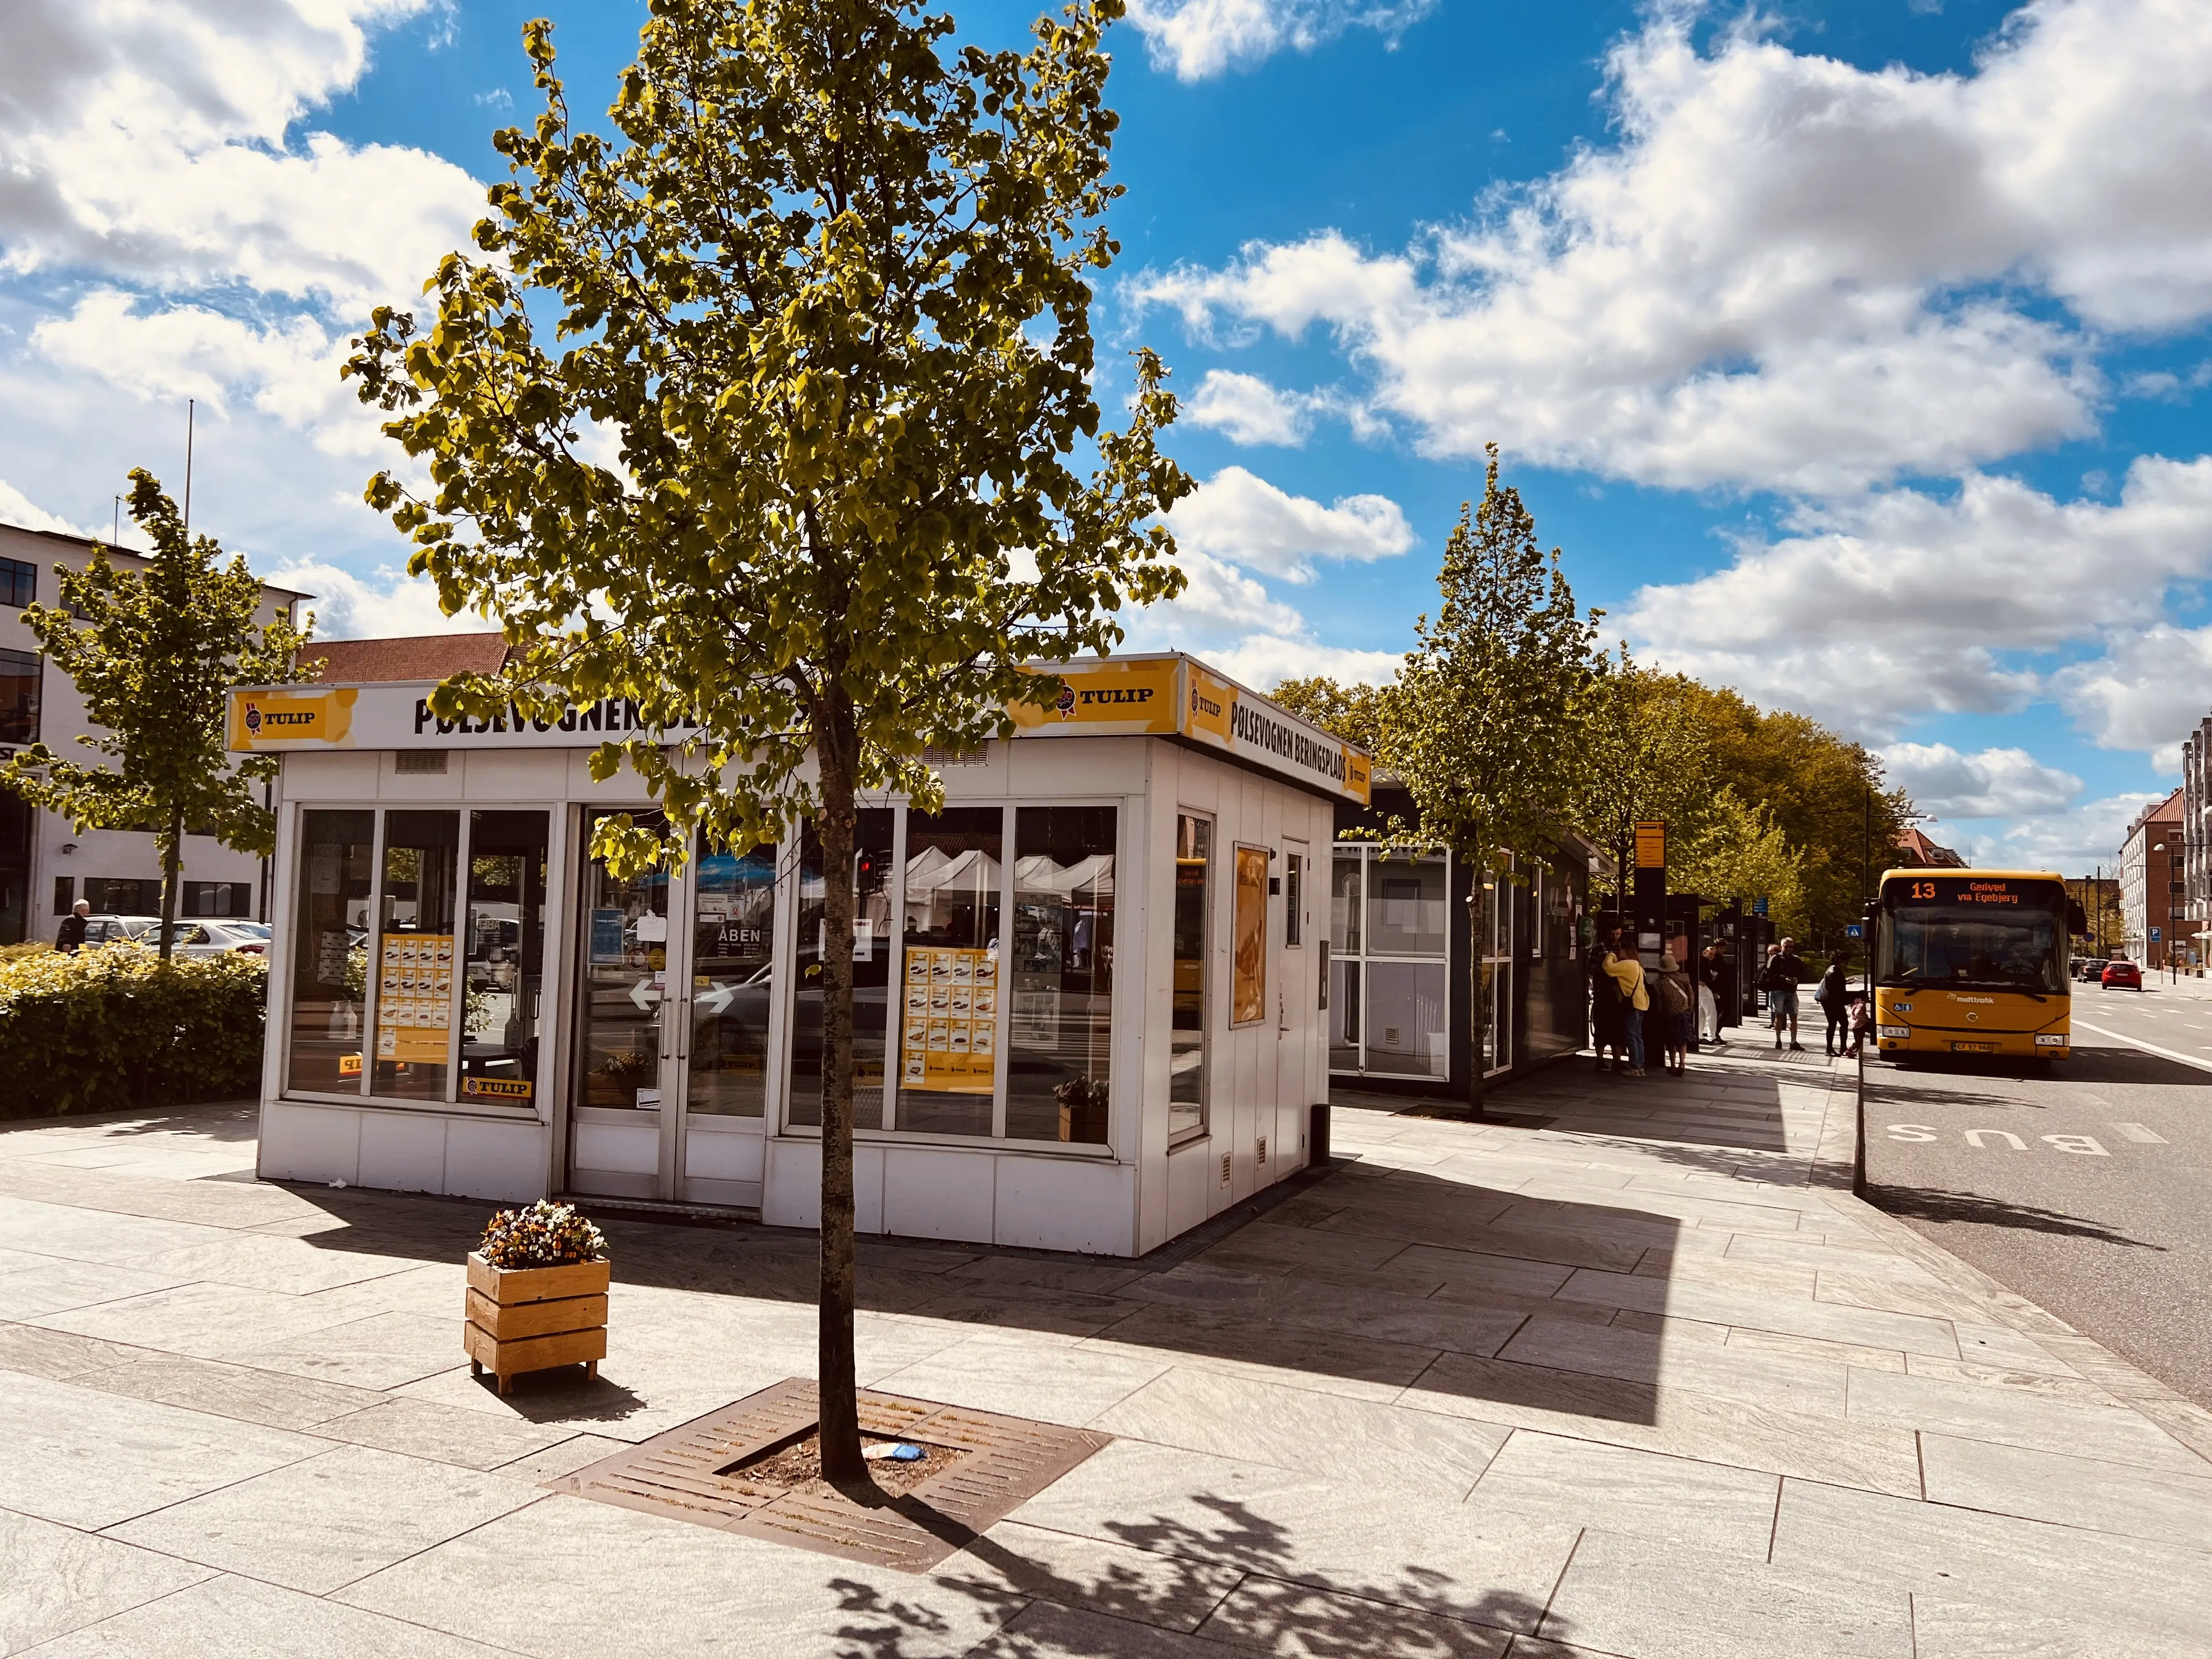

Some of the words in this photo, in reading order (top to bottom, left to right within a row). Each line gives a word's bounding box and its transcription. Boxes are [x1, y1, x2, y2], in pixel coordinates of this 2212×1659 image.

[1080, 689, 1153, 704] TULIP
[1199, 696, 1221, 718] TULIP
[265, 713, 315, 725] TULIP
[1231, 701, 1293, 760] PØLSEVOGNEN
[1295, 733, 1346, 783] BERINGSPLADS
[1354, 769, 1366, 783] TULIP
[1911, 882, 1936, 899] 13
[1970, 882, 2006, 892] Gedved
[1957, 893, 1972, 901] via
[1975, 893, 2018, 904] Egebjerg
[718, 926, 760, 942] ÅBEN
[479, 1081, 528, 1094] TULIP
[1886, 1124, 2112, 1156] BUS
